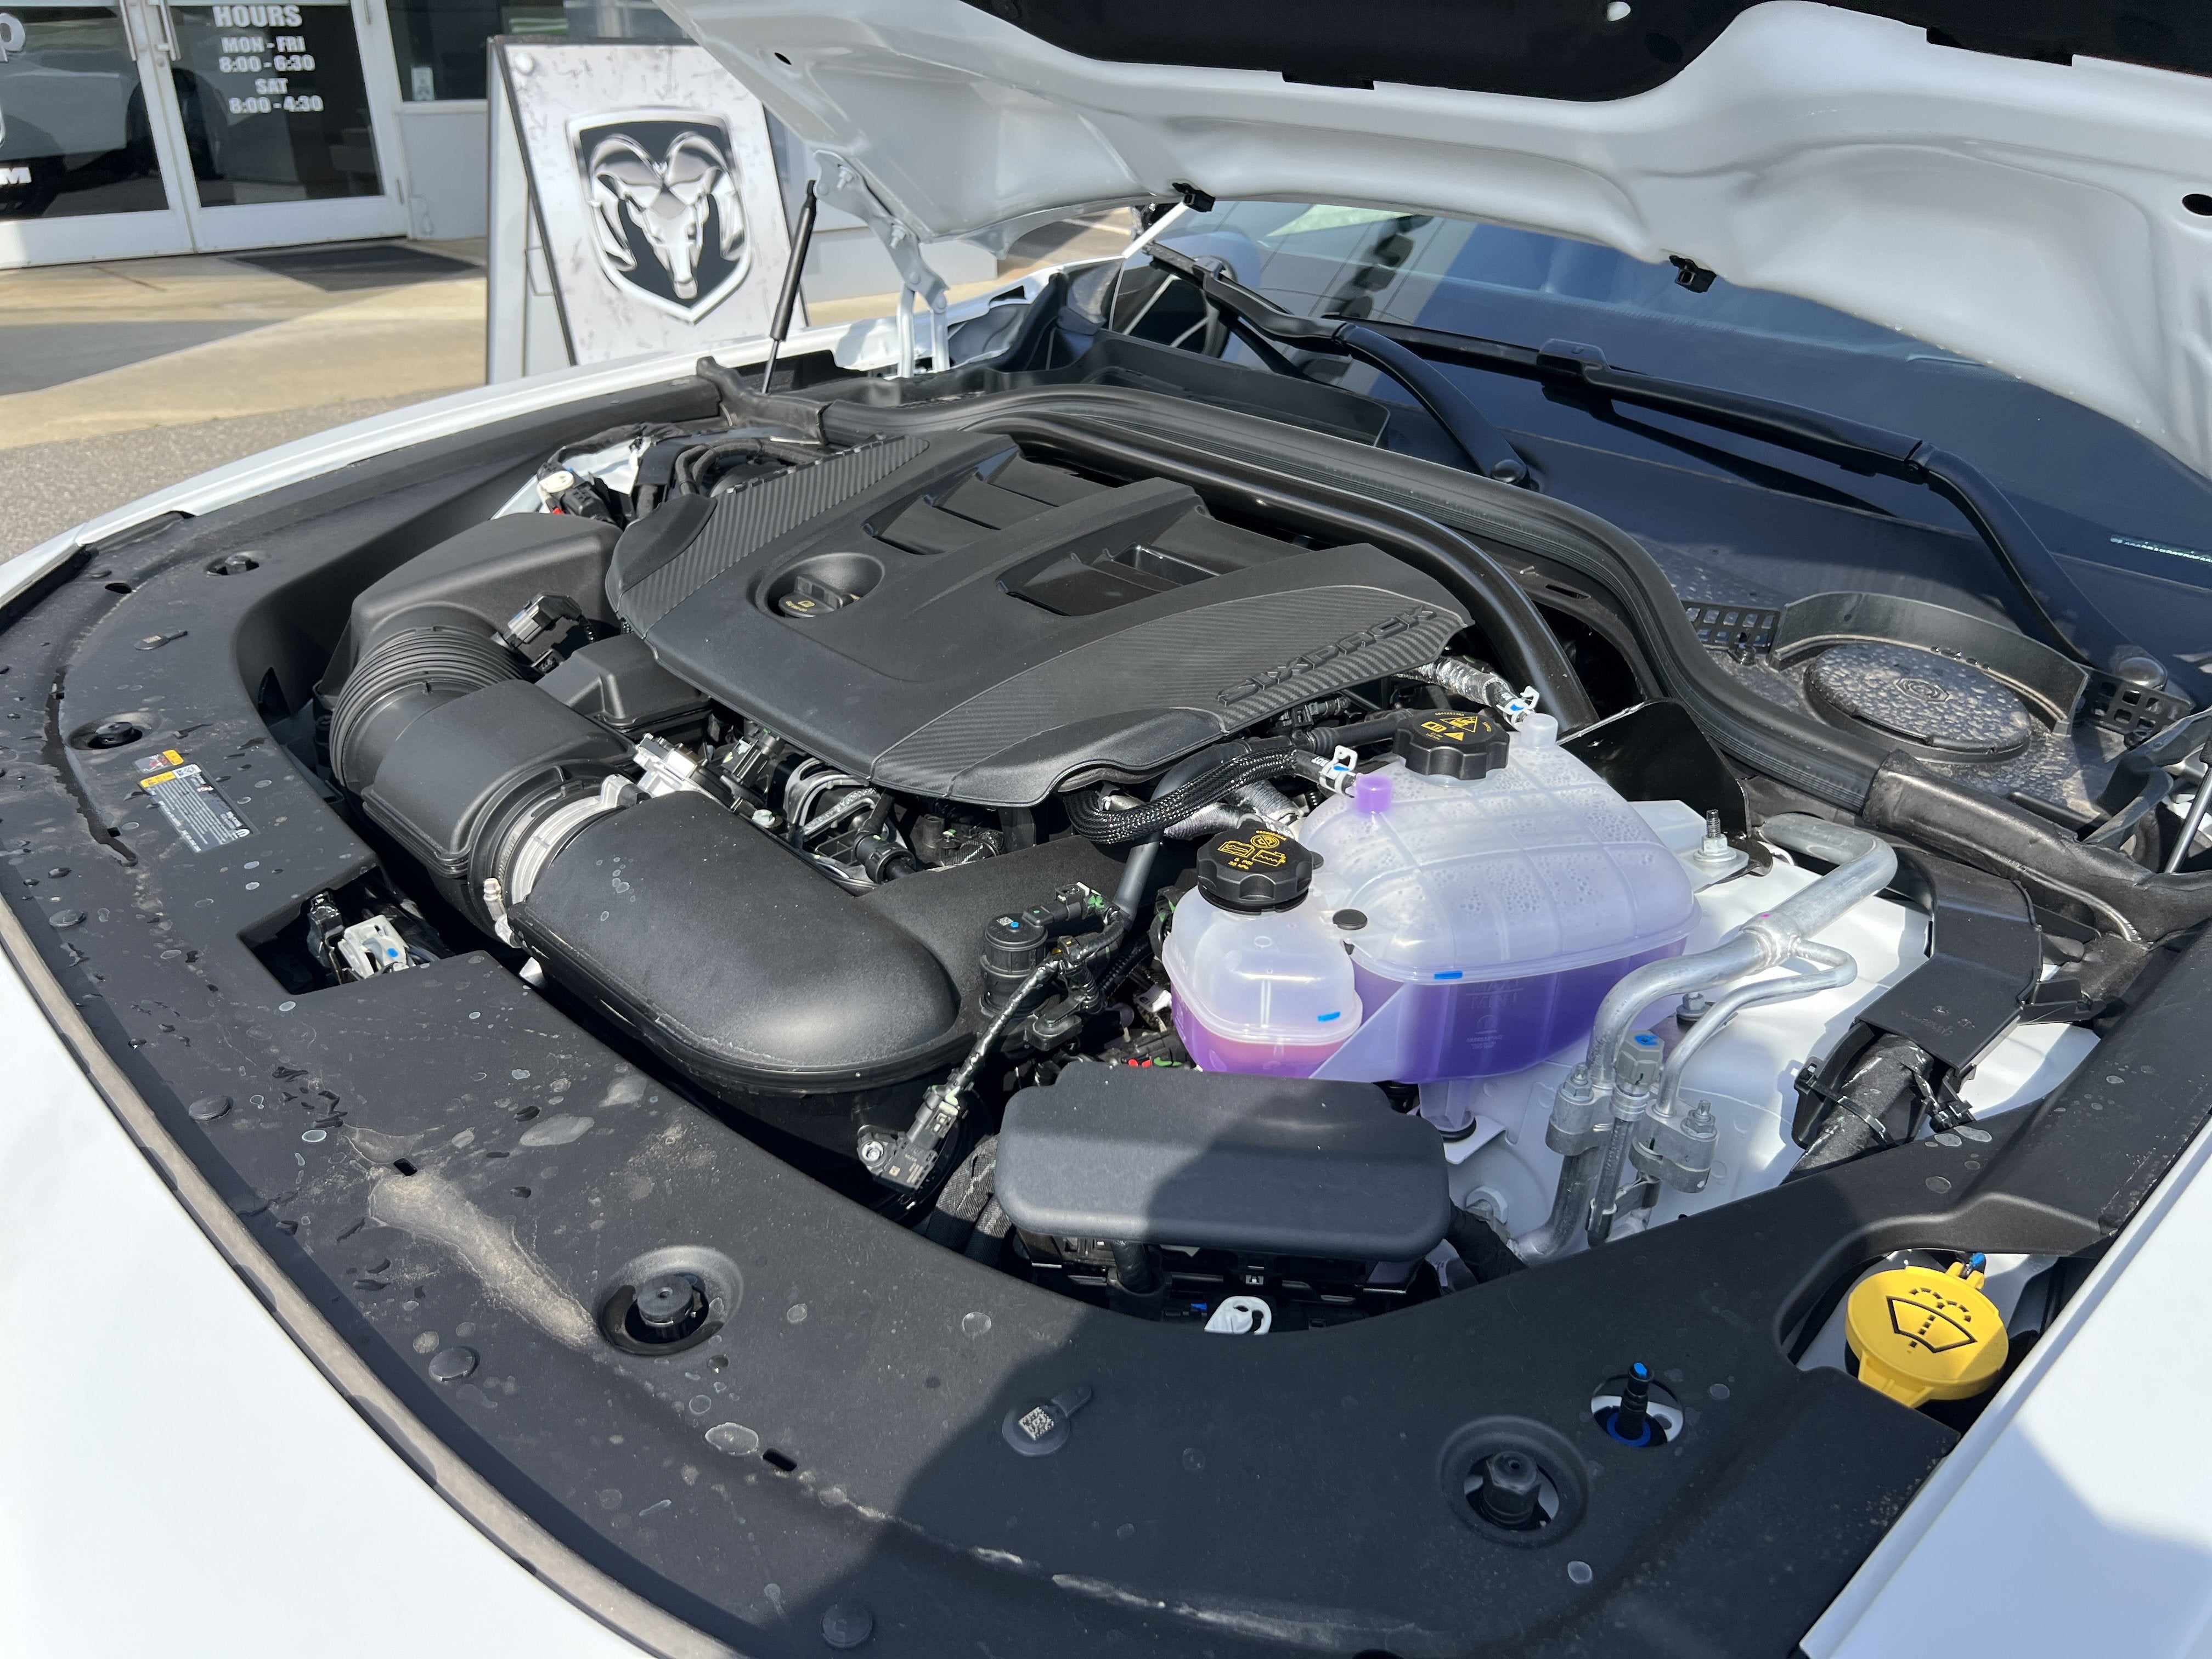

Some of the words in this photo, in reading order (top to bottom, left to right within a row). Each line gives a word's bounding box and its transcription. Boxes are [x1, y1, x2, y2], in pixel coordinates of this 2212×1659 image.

[213, 4, 302, 27] HOURS
[221, 36, 265, 53] MON
[276, 36, 306, 52] FRI
[219, 56, 262, 72] 8:00
[274, 54, 315, 71] 6:30
[255, 78, 289, 94] SAT
[229, 97, 272, 114] 8:00
[284, 95, 324, 112] 4:30
